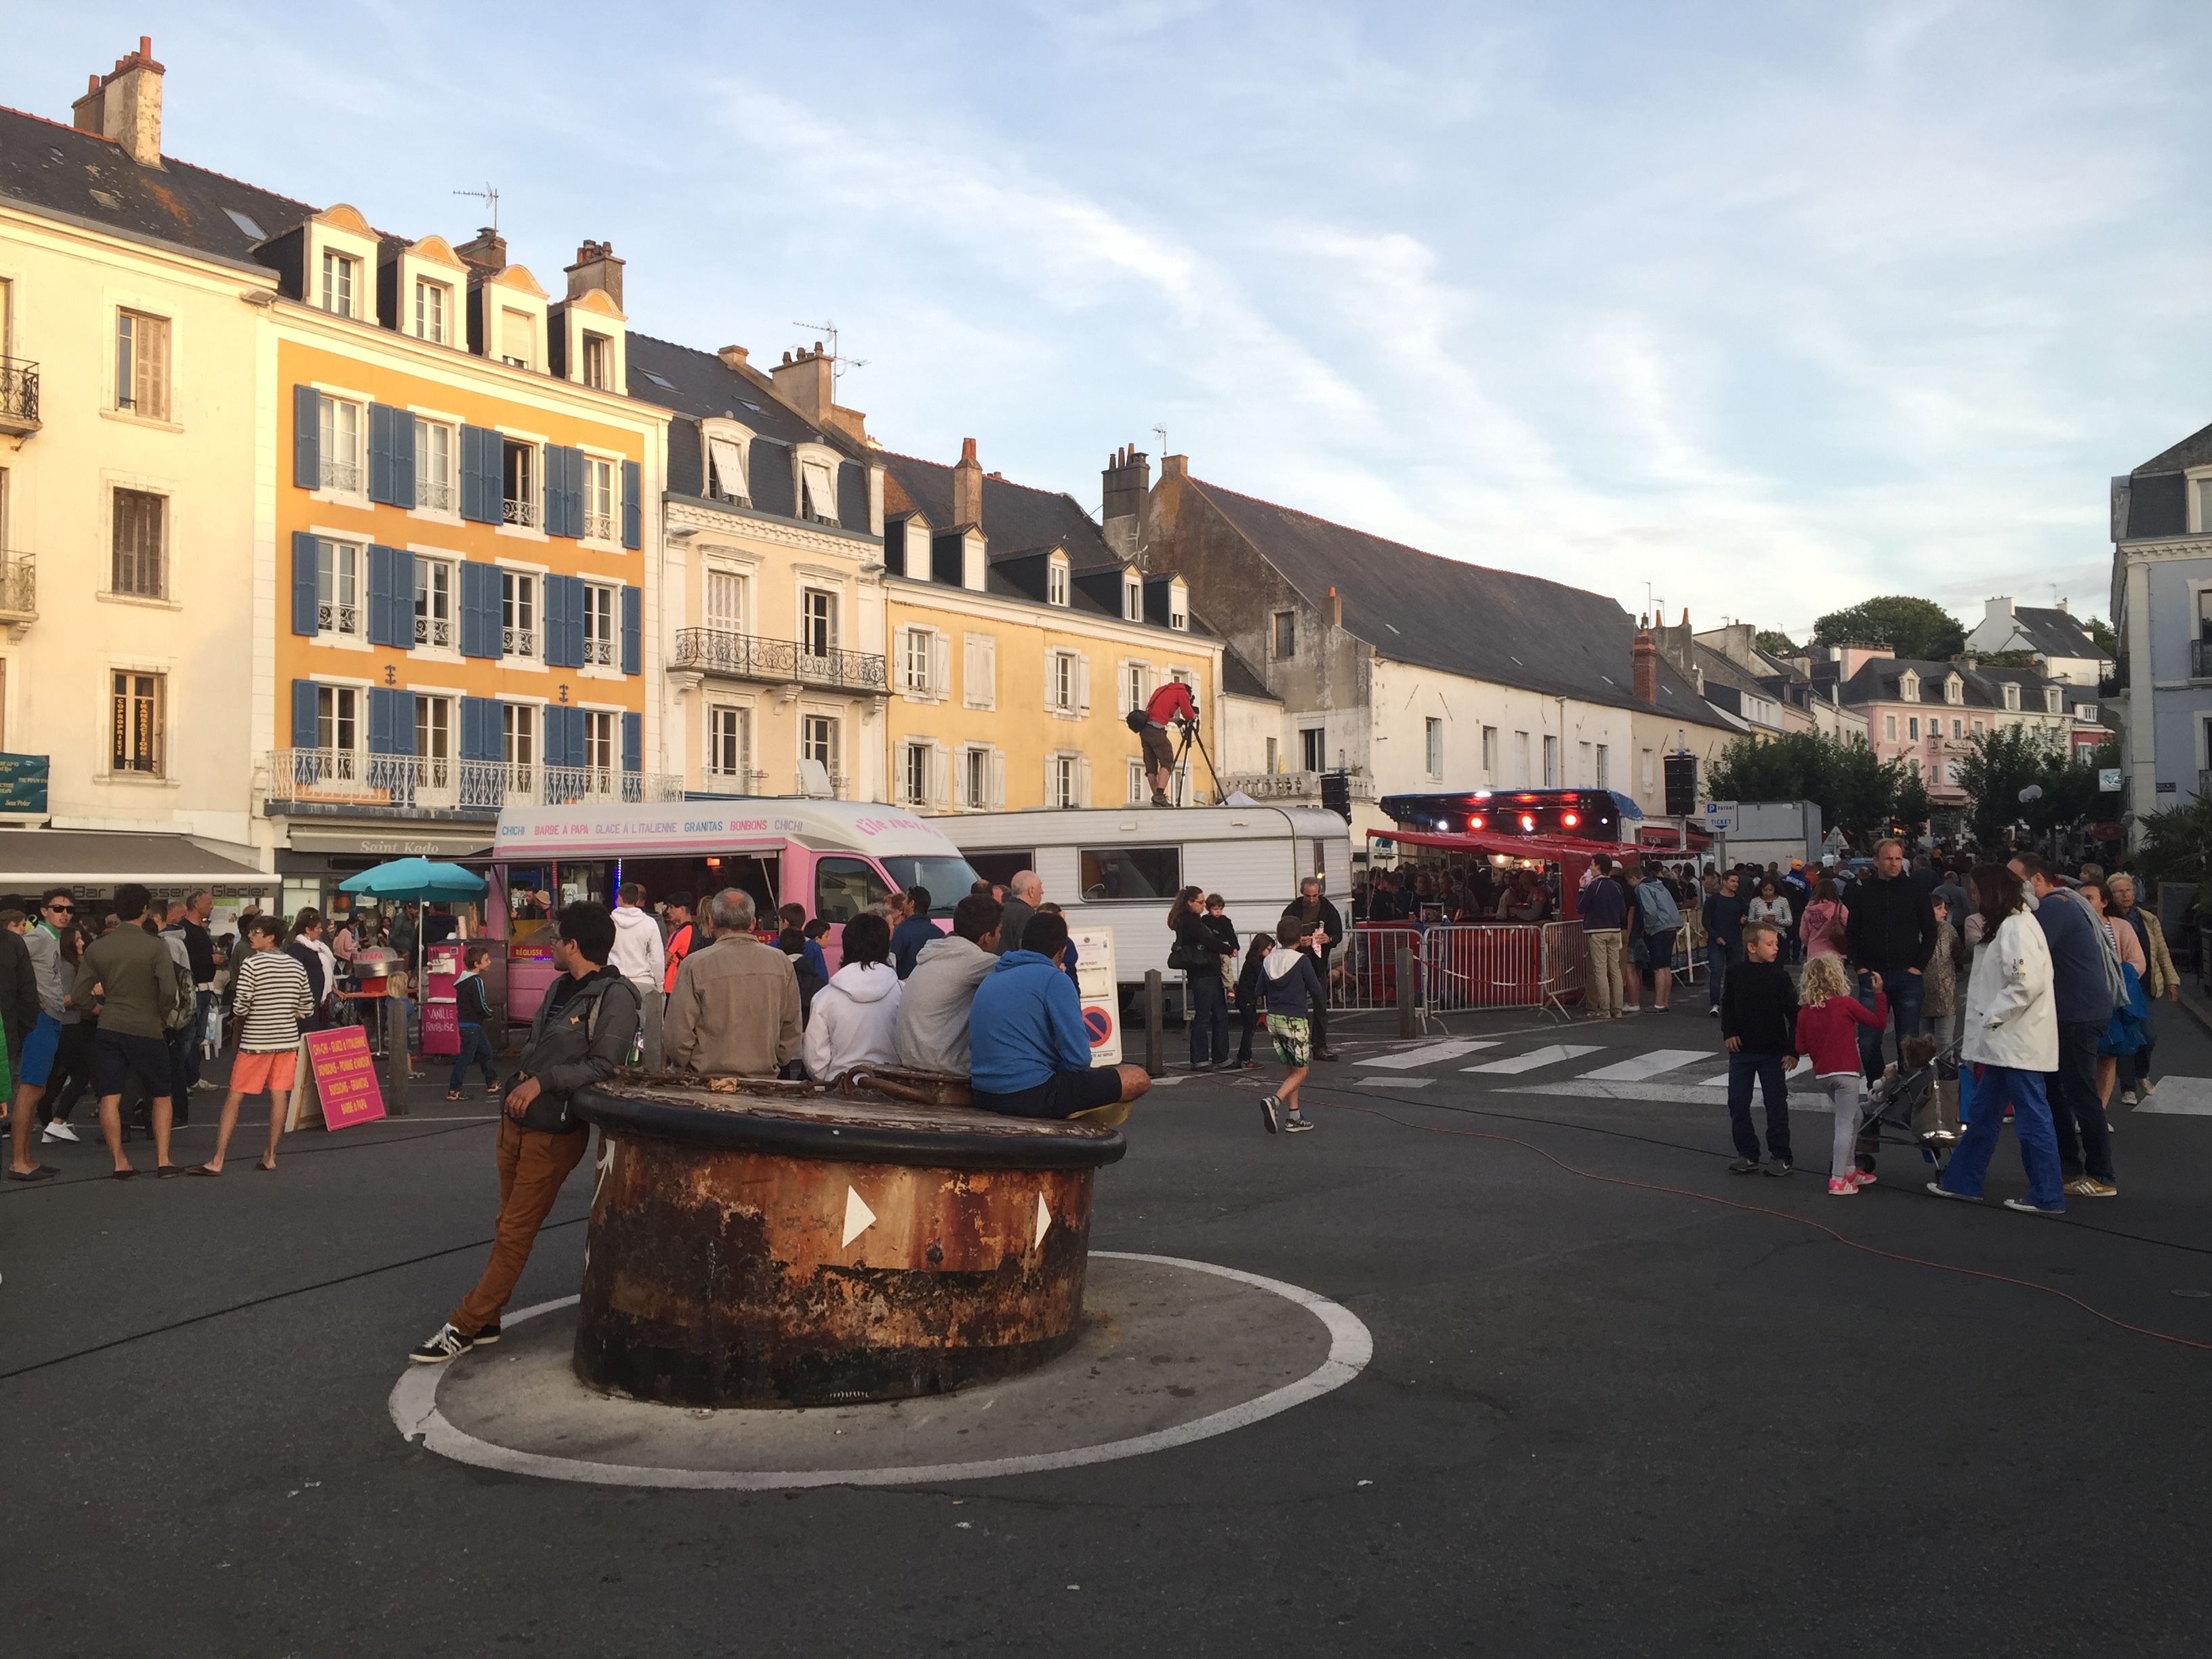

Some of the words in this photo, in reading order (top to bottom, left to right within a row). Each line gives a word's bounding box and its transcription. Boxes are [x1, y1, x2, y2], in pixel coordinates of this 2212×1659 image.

[1708, 804, 1715, 813] P
[501, 825, 525, 836] CHICHI
[534, 824, 560, 836] BARBE
[571, 824, 589, 835] PAPA
[595, 823, 620, 834] GLACE
[684, 821, 723, 832] GRANITAS
[730, 819, 768, 832] BONBONS
[774, 819, 803, 832] CHICHI
[360, 840, 398, 853] Saint
[404, 841, 439, 854] Kado
[73, 885, 106, 898] Bar
[211, 884, 269, 897] Glacier
[515, 947, 543, 956] RÉGLISSE
